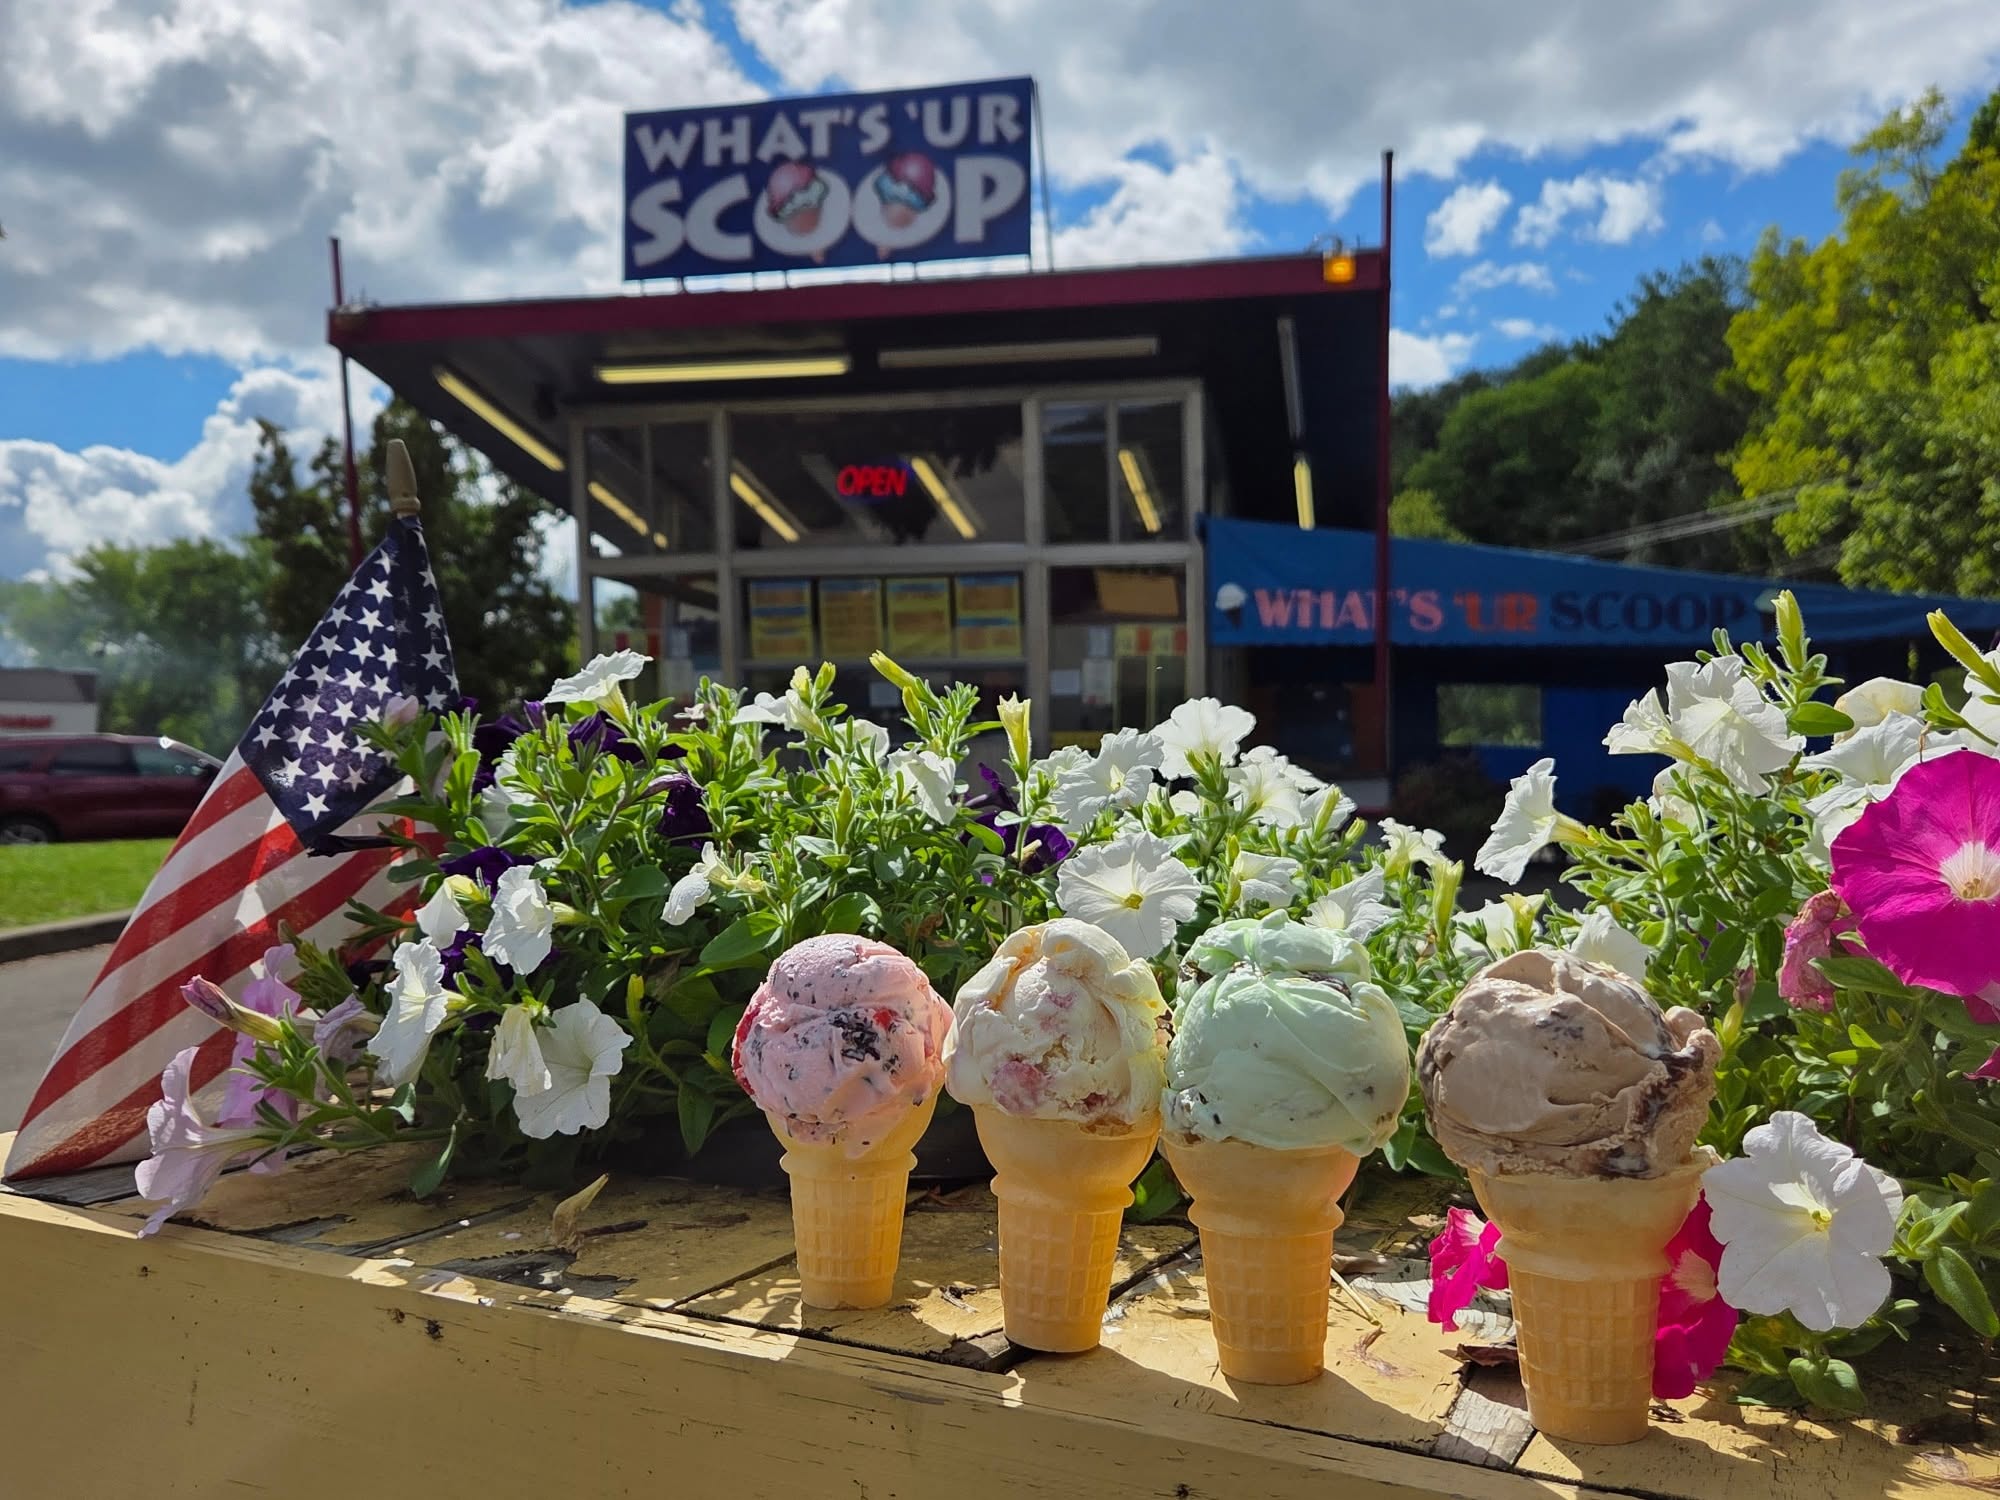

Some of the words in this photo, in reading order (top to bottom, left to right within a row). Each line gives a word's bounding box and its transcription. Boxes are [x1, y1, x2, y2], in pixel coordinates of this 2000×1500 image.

[634, 103, 891, 172] WHAT'S
[905, 94, 1024, 148] 'UR
[630, 156, 1026, 268] SCOOP
[837, 465, 907, 496] OPEN
[1454, 591, 1538, 633] 'UR
[1550, 590, 1746, 634] SCOOP
